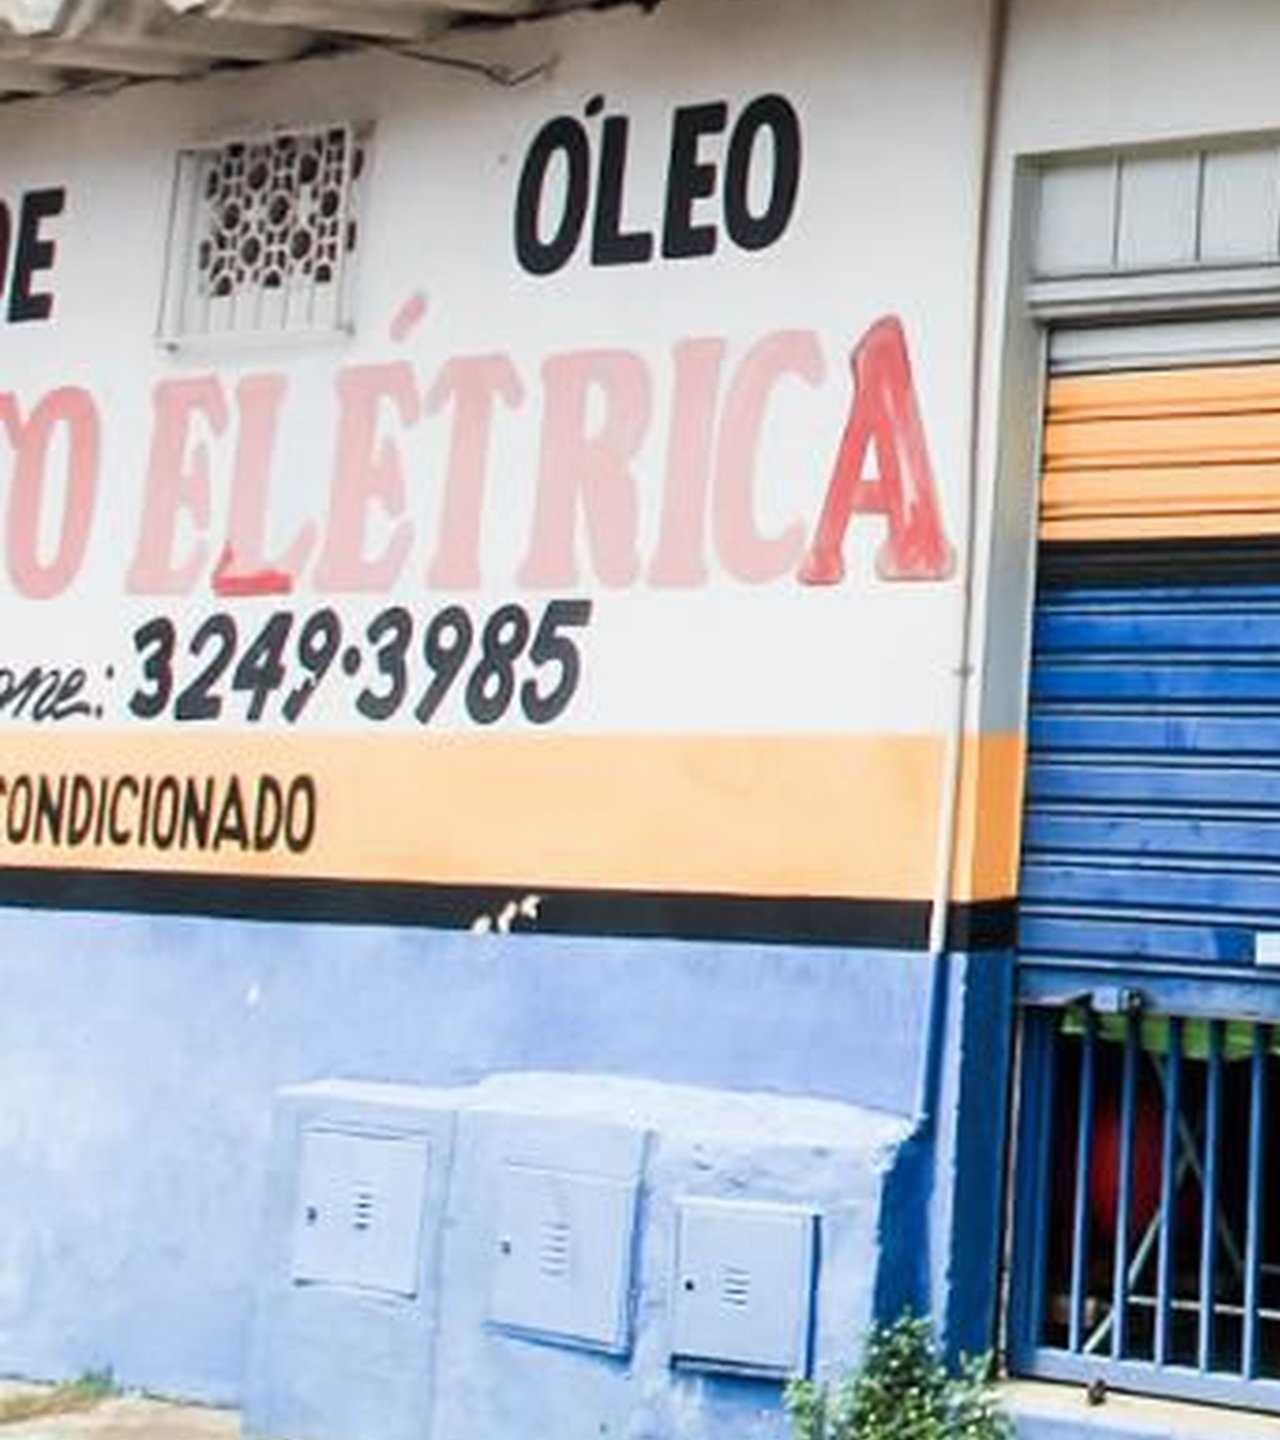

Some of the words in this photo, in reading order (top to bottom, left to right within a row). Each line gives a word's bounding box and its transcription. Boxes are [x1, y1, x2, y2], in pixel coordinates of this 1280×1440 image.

[0, 186, 66, 323] E
[514, 93, 802, 276] ÓLEO
[0, 385, 101, 600] O
[125, 288, 957, 597] ELÉTRICA
[0, 772, 317, 854] ONDICIONADO
